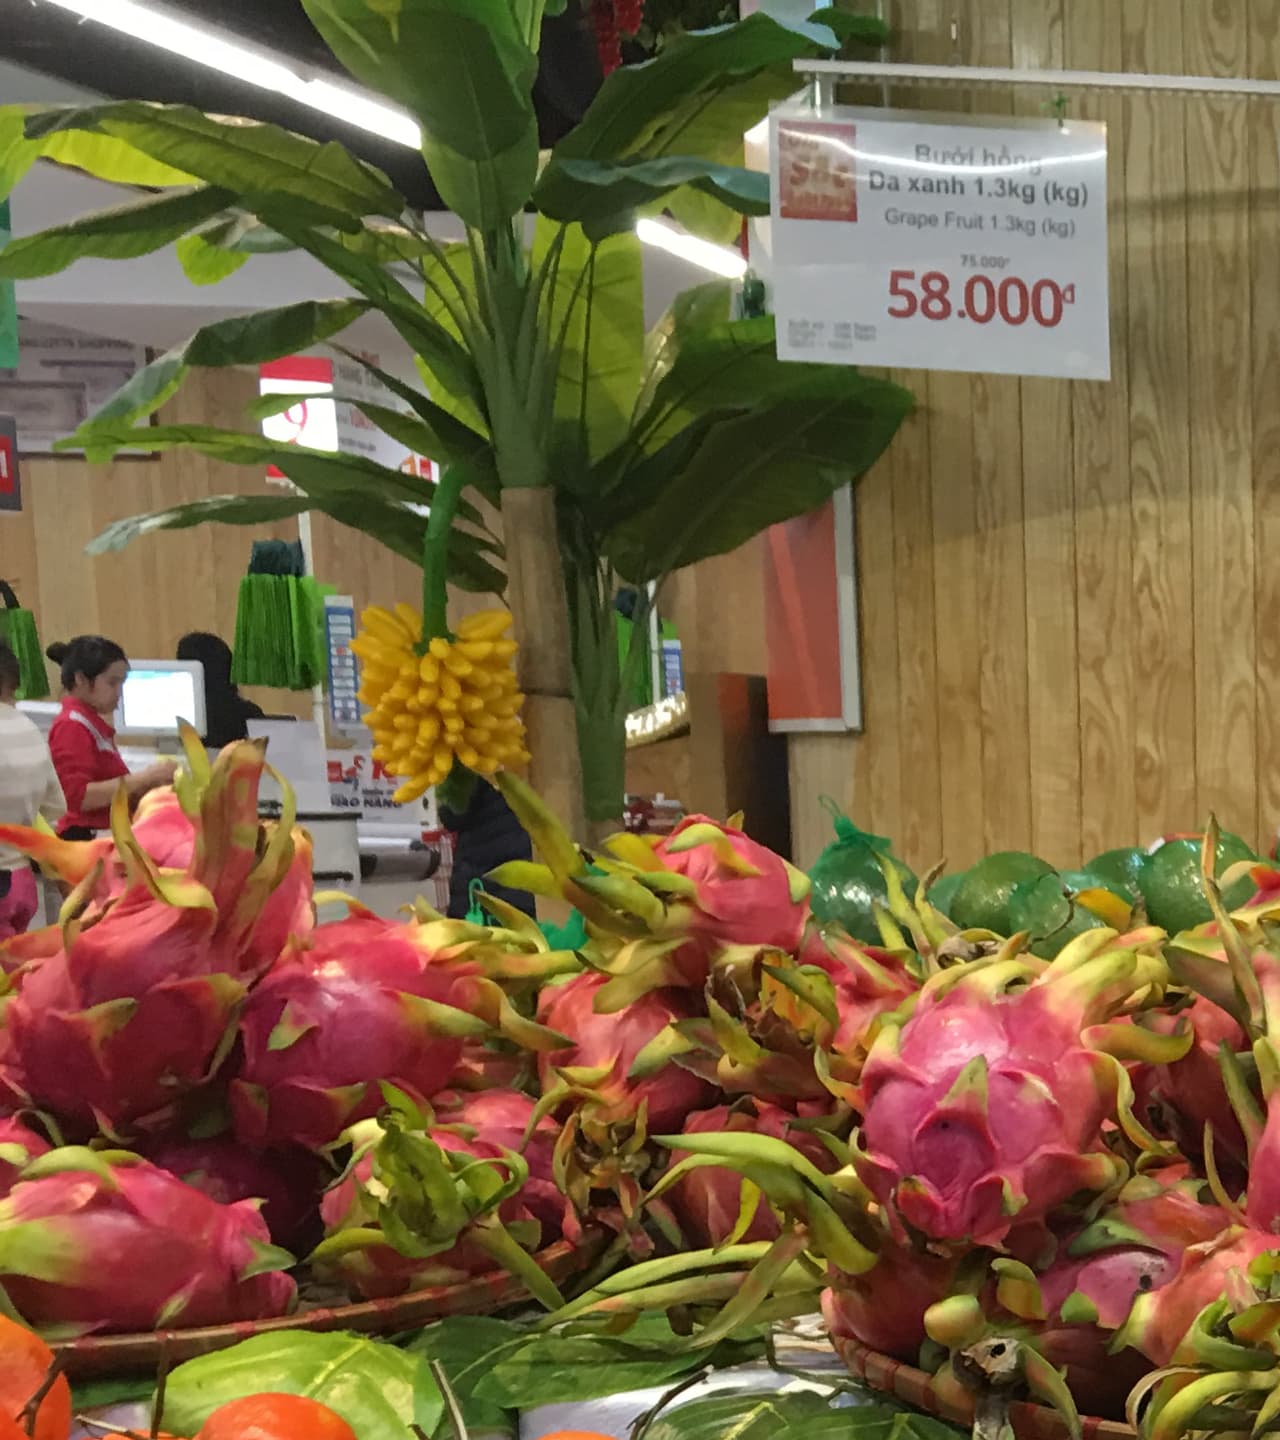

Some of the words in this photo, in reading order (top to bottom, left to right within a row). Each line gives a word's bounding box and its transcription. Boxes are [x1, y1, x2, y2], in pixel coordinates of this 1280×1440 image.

[868, 170, 900, 192] Da
[908, 174, 966, 196] xanh
[974, 176, 1037, 206] 1.3kg
[1043, 180, 1089, 208] (kg)
[884, 207, 939, 230] Grape
[944, 210, 985, 231] Fruit
[1041, 217, 1077, 239] (kg)
